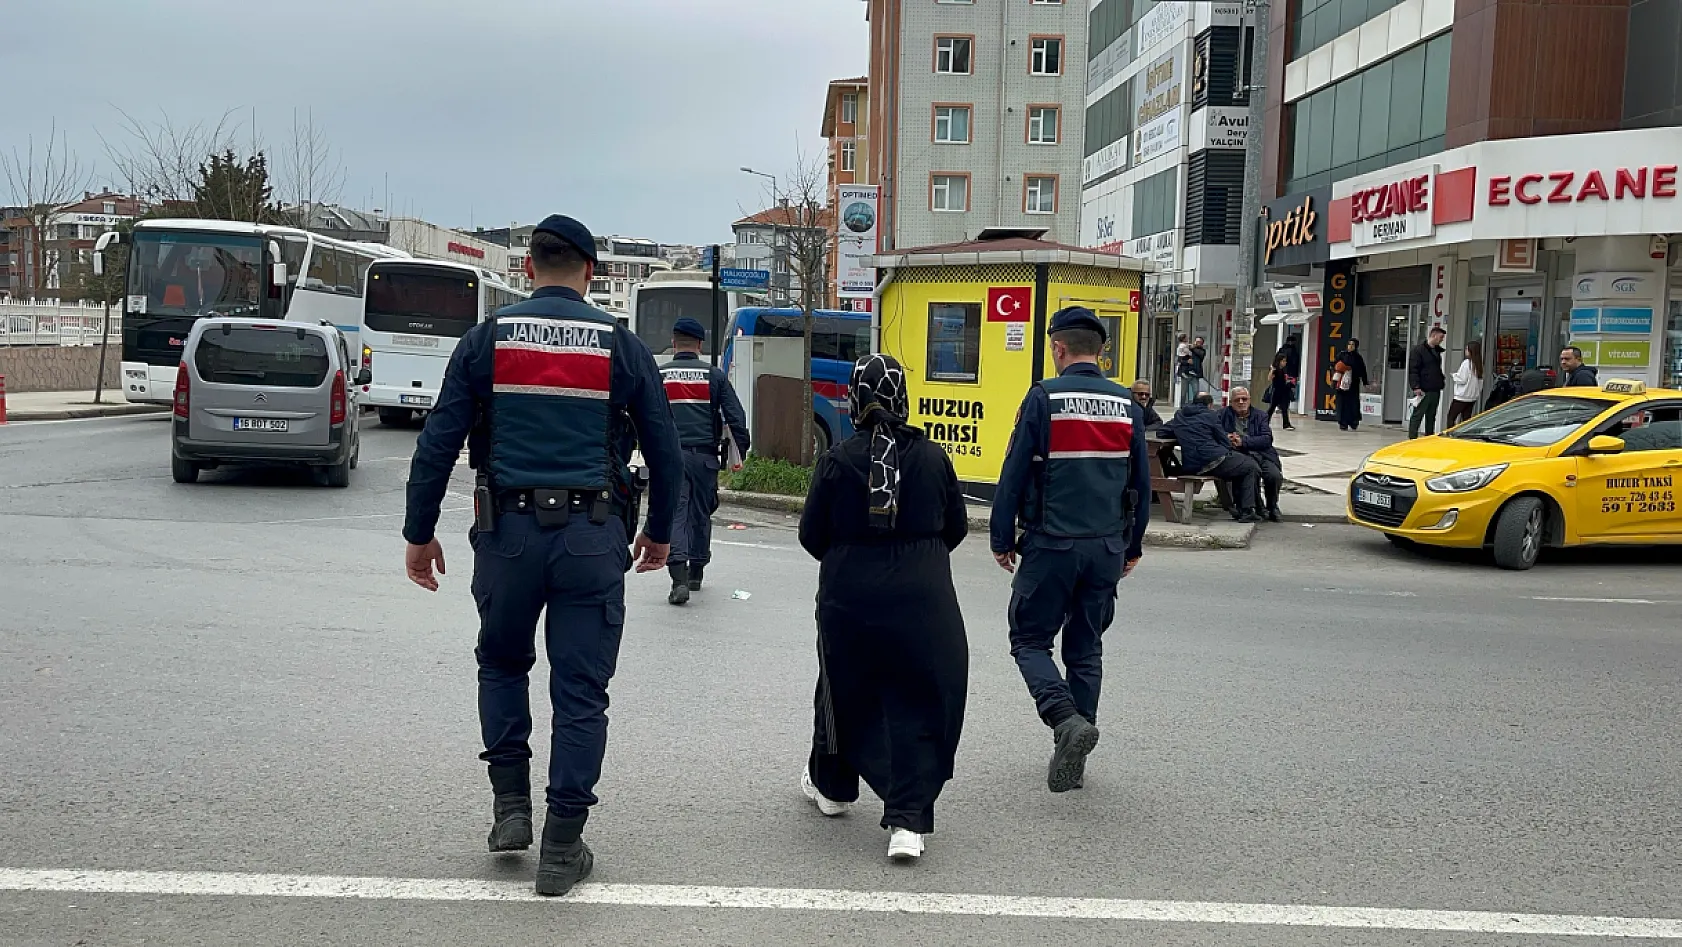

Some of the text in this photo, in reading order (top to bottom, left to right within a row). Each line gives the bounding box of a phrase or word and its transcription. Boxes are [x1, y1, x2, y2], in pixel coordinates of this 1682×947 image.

[1488, 165, 1678, 206] ECZANE
[1352, 174, 1428, 224] ECZANE
[1373, 219, 1407, 238] DERMAN
[1434, 265, 1445, 327] EC
[1615, 283, 1636, 292] SGK
[507, 322, 600, 348] JANDARMA
[918, 397, 983, 419] HUZUR
[1060, 398, 1127, 418] JANDARMA
[923, 421, 977, 443] TAKSİ
[956, 444, 967, 456] 43
[970, 445, 982, 457] 45
[1606, 475, 1673, 489] HUZUR TAKSİ
[1649, 491, 1659, 501] 43
[1663, 490, 1673, 500] 45
[1601, 503, 1620, 513] 59
[1625, 502, 1635, 513] T
